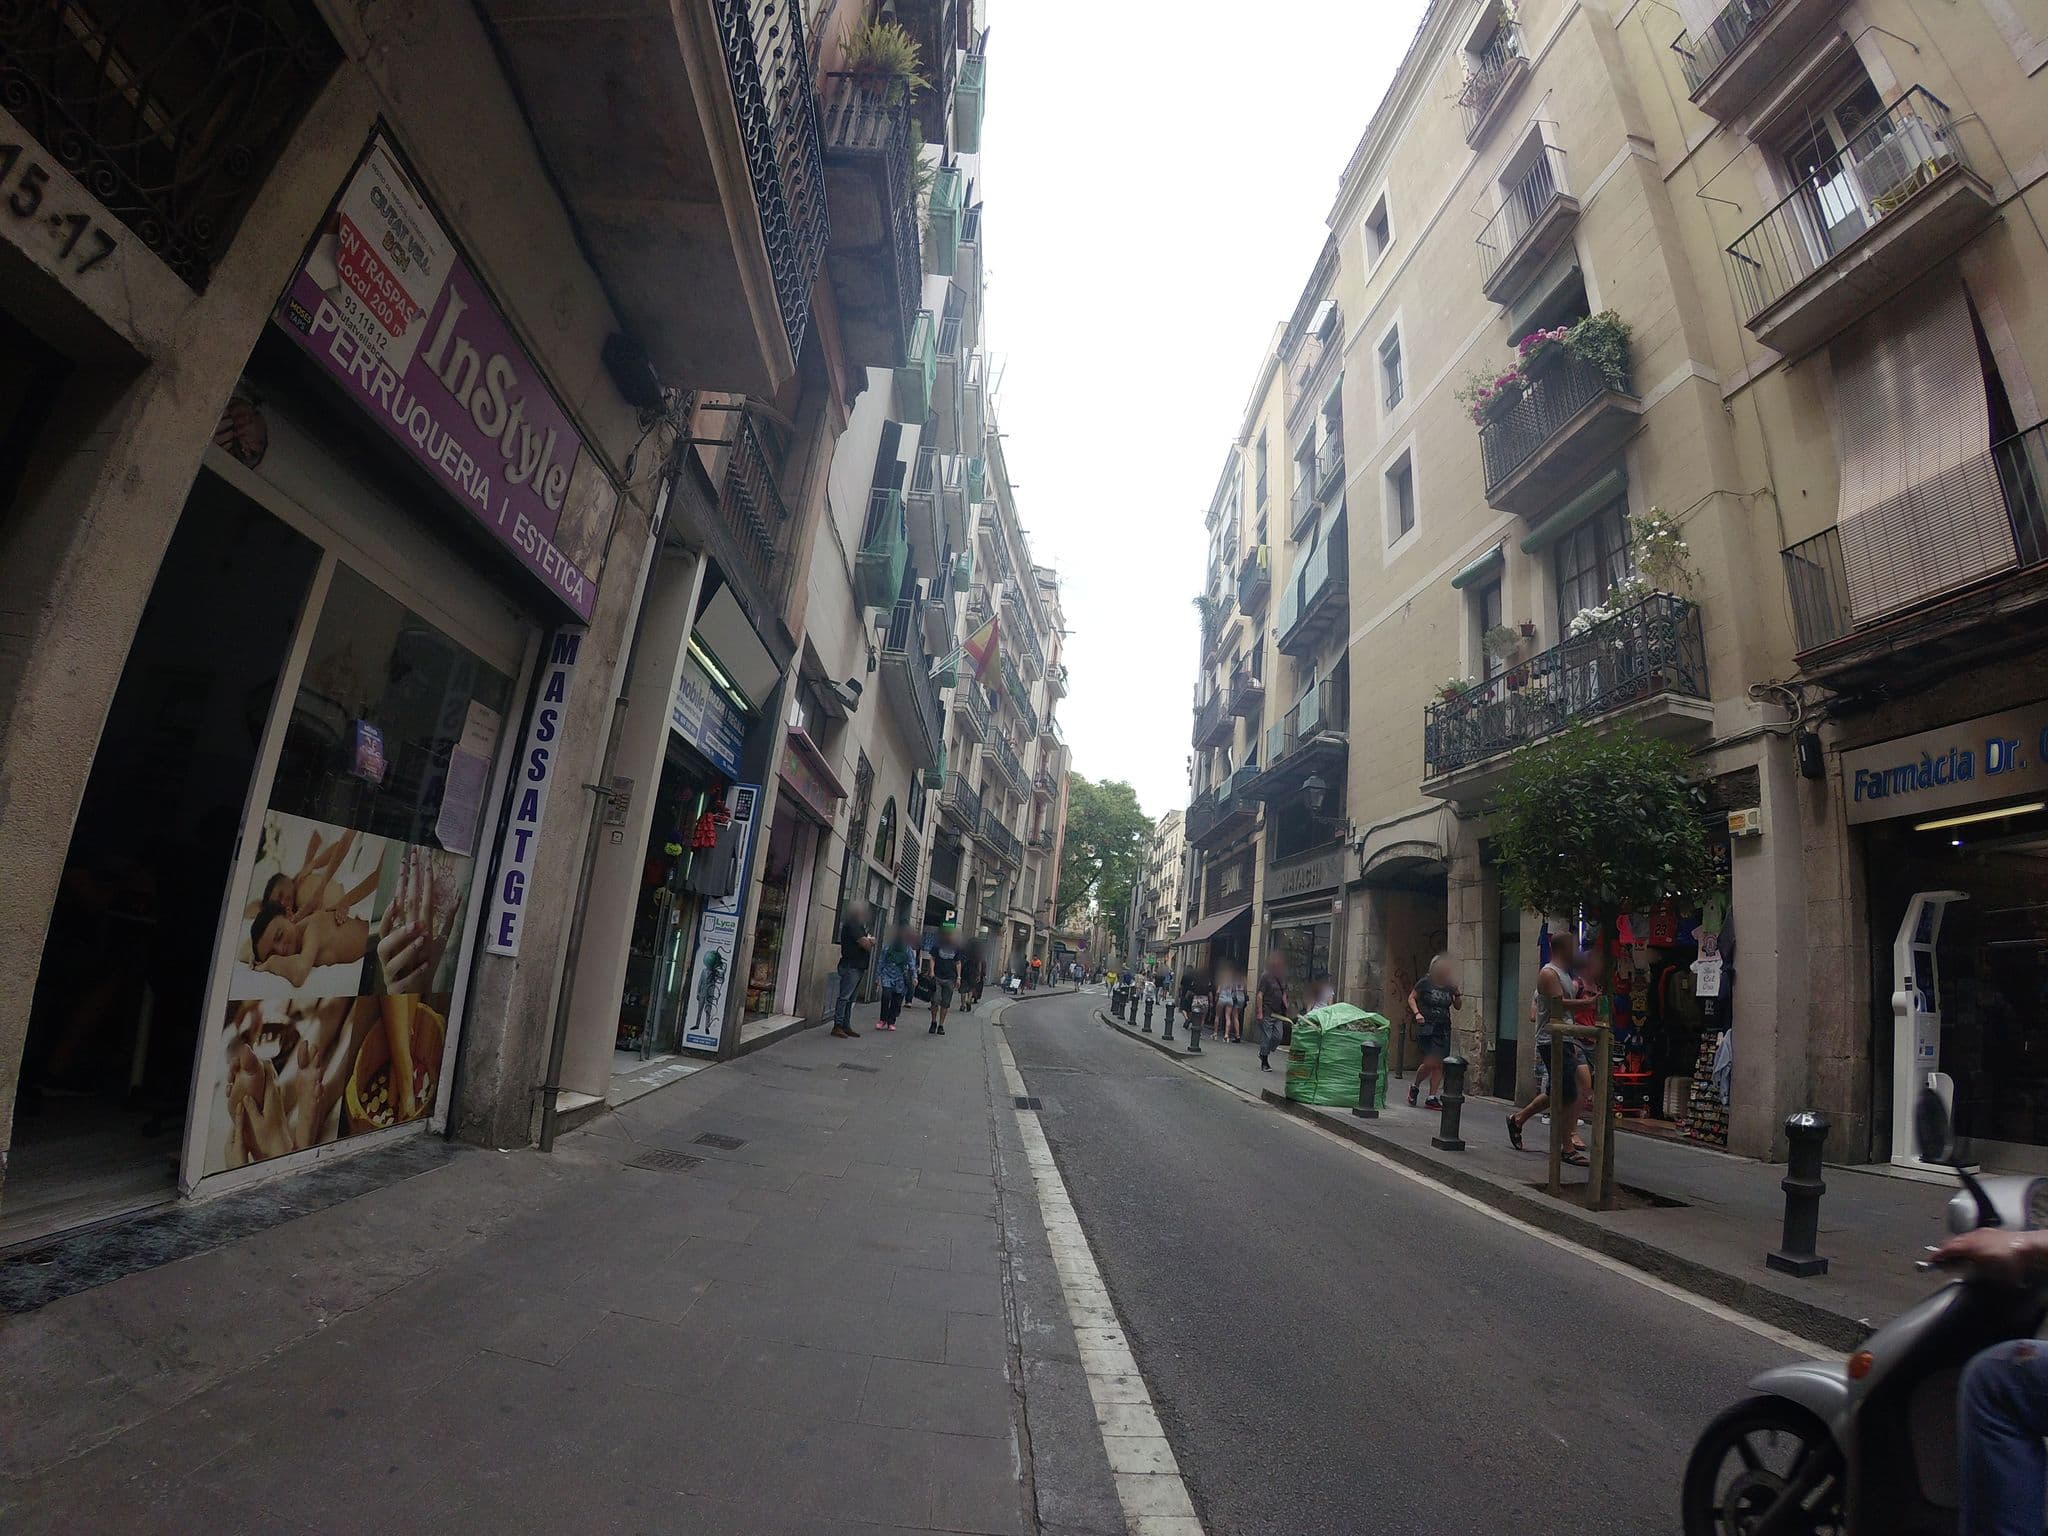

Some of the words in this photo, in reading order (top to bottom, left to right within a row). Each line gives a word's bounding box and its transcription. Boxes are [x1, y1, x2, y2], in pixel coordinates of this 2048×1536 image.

[337, 254, 371, 299] Local
[370, 291, 394, 324] 200
[339, 223, 361, 256] EN
[358, 249, 415, 323] TRASPAS
[344, 296, 358, 315] 93
[358, 311, 376, 337] 118
[375, 332, 388, 350] 12
[421, 284, 569, 511] InStyle
[310, 298, 490, 512] PERRUQUERIA
[496, 502, 506, 526] I
[511, 512, 587, 605] ESTETICA
[498, 632, 580, 948] MASSATGE
[1854, 747, 1976, 802] Farmàcia
[1984, 735, 2029, 777] Dr.
[715, 917, 736, 929] Lyca
[945, 909, 956, 922] P
